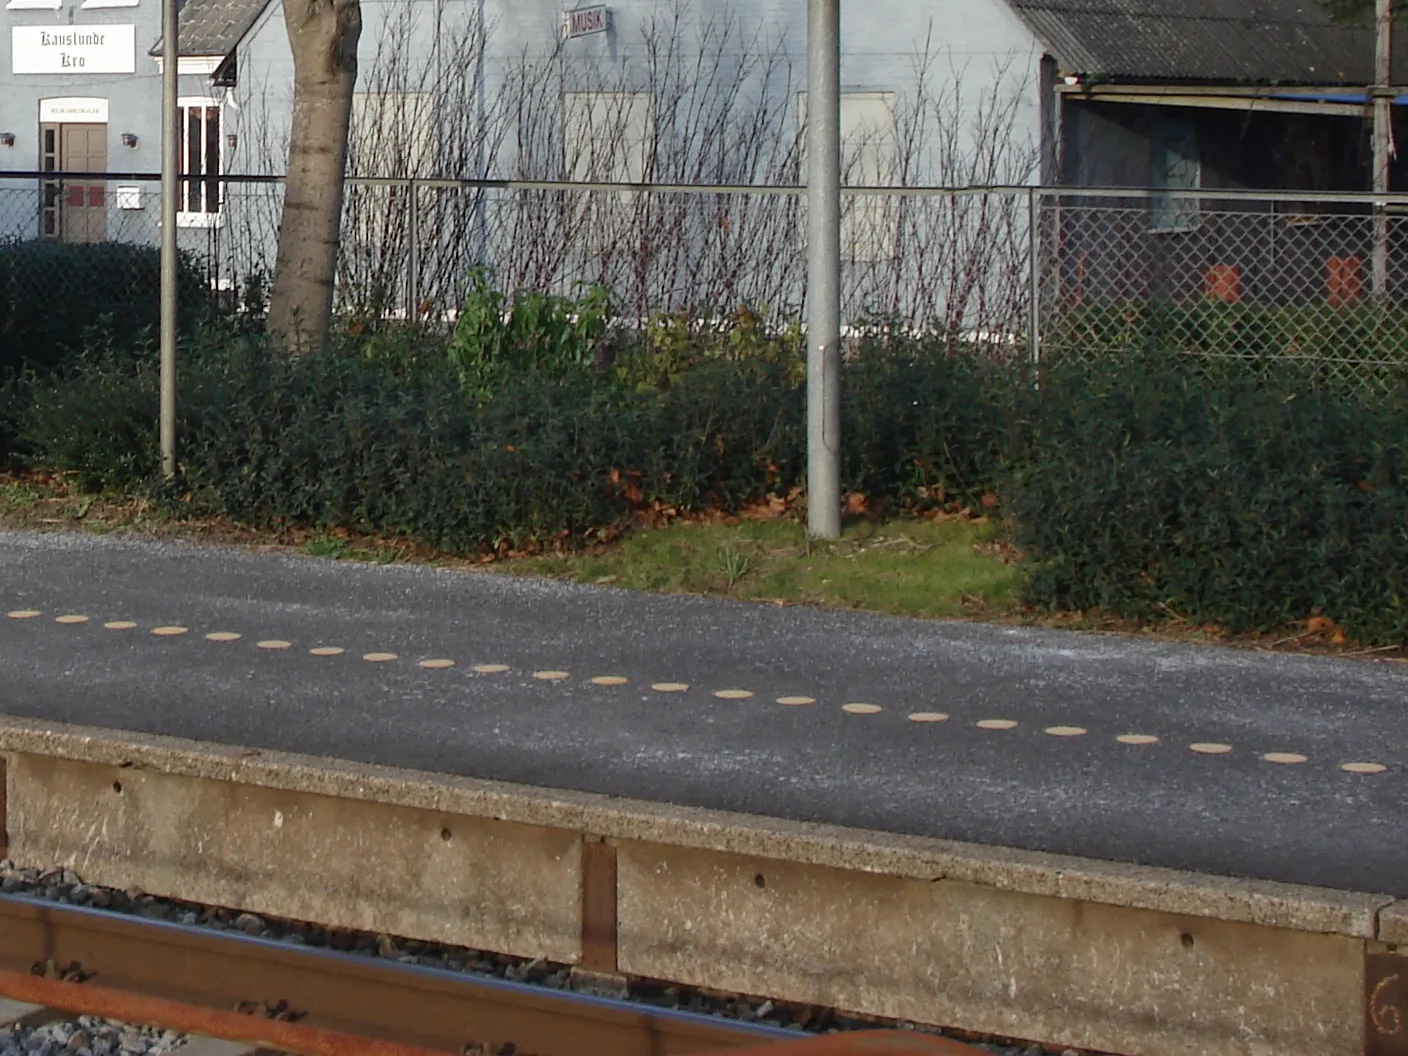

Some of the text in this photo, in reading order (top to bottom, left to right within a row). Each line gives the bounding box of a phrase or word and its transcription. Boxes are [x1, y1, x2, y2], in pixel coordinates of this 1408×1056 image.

[570, 10, 603, 33] MUSIK
[60, 52, 86, 68] Kro
[1371, 973, 1401, 1034] 6
